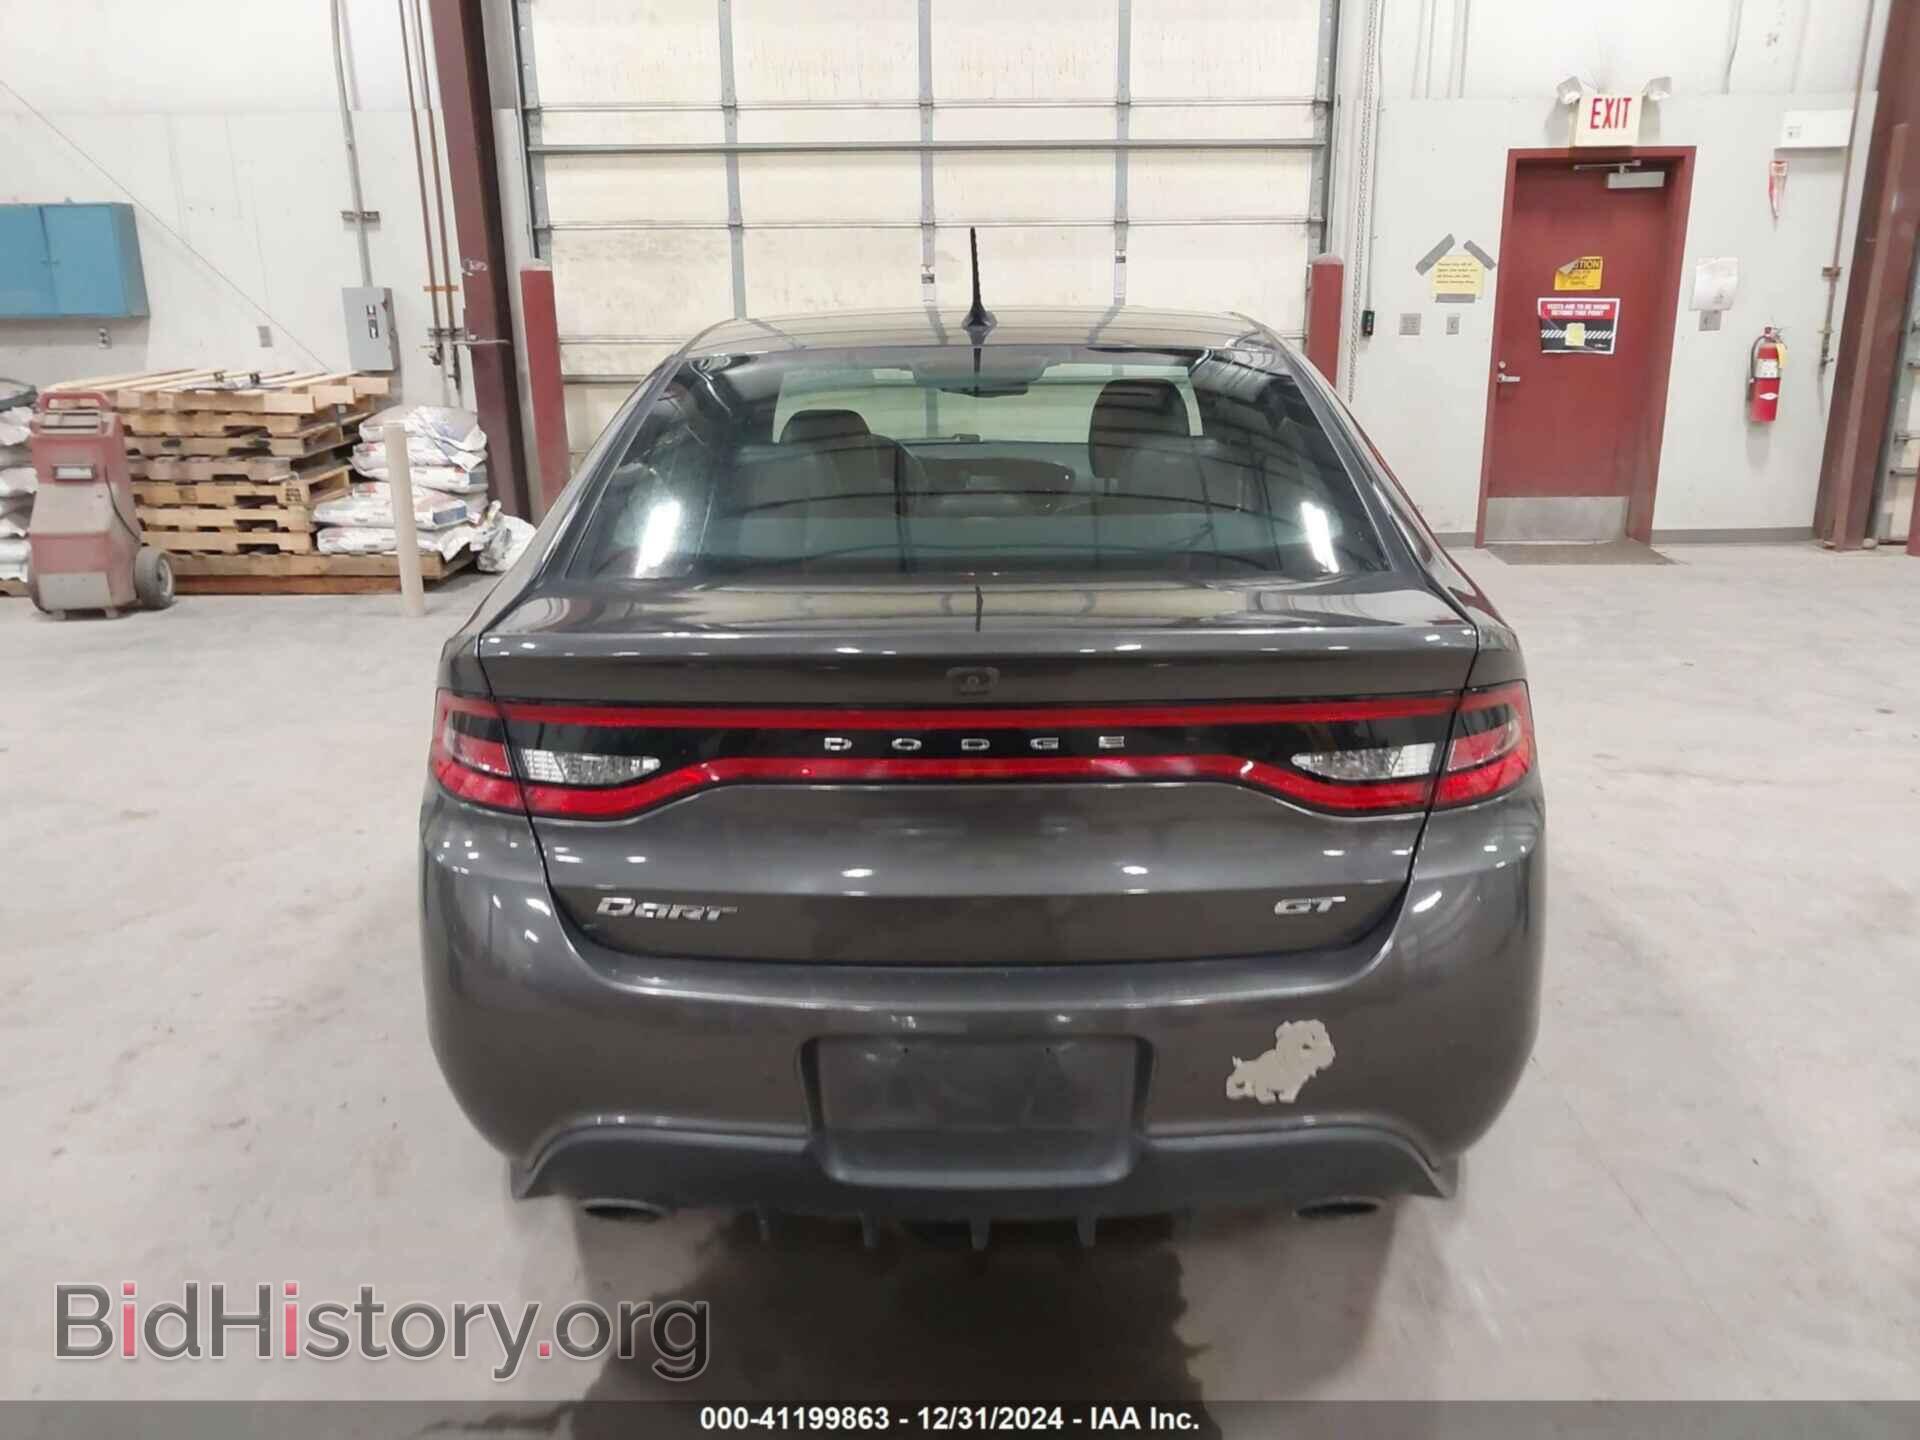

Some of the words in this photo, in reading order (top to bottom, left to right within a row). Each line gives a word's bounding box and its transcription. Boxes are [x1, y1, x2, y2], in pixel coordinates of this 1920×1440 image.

[1590, 97, 1632, 129] EXIT
[824, 736, 1125, 750] DODGE
[1274, 896, 1346, 915] GT
